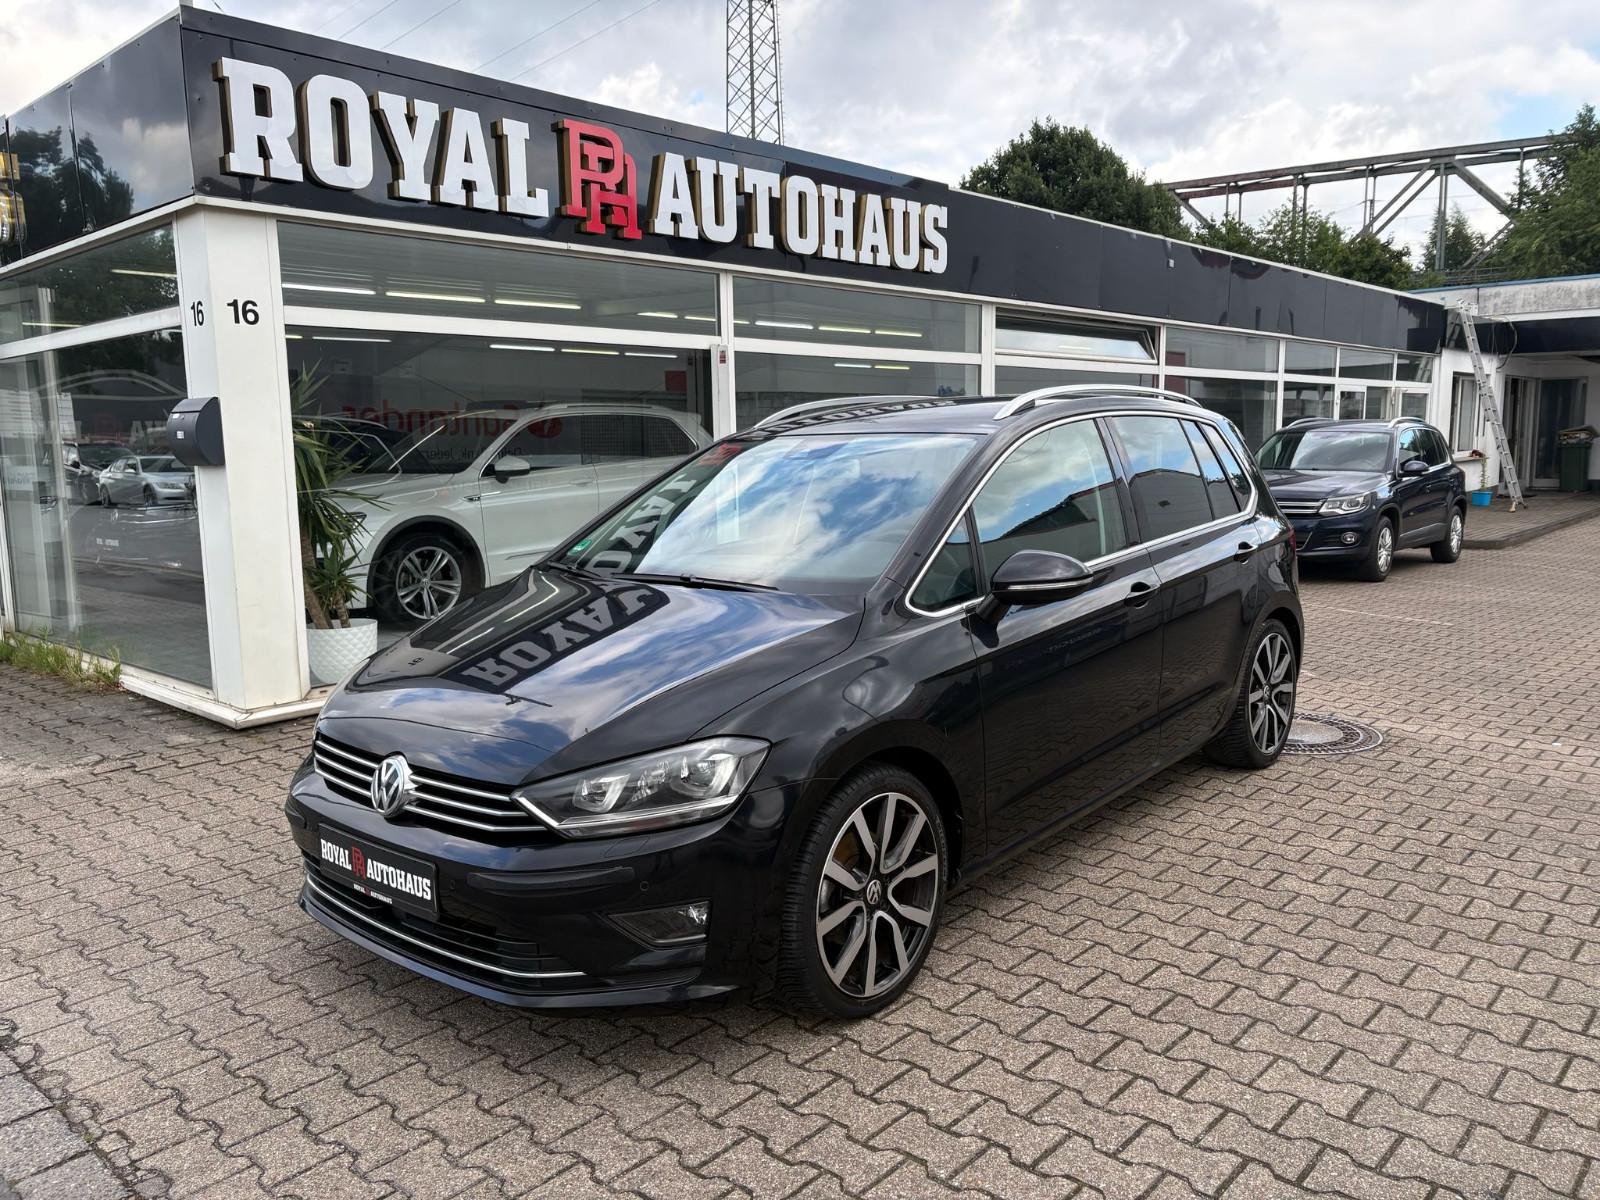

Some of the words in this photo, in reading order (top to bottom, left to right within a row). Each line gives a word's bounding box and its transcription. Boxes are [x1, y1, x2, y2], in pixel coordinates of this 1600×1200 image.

[214, 57, 549, 218] ROYAL
[649, 152, 949, 274] AUTOHAUS
[190, 300, 205, 327] 16
[227, 299, 260, 326] 16
[320, 838, 352, 871] ROYAL
[366, 858, 432, 901] AUTOHAUS
